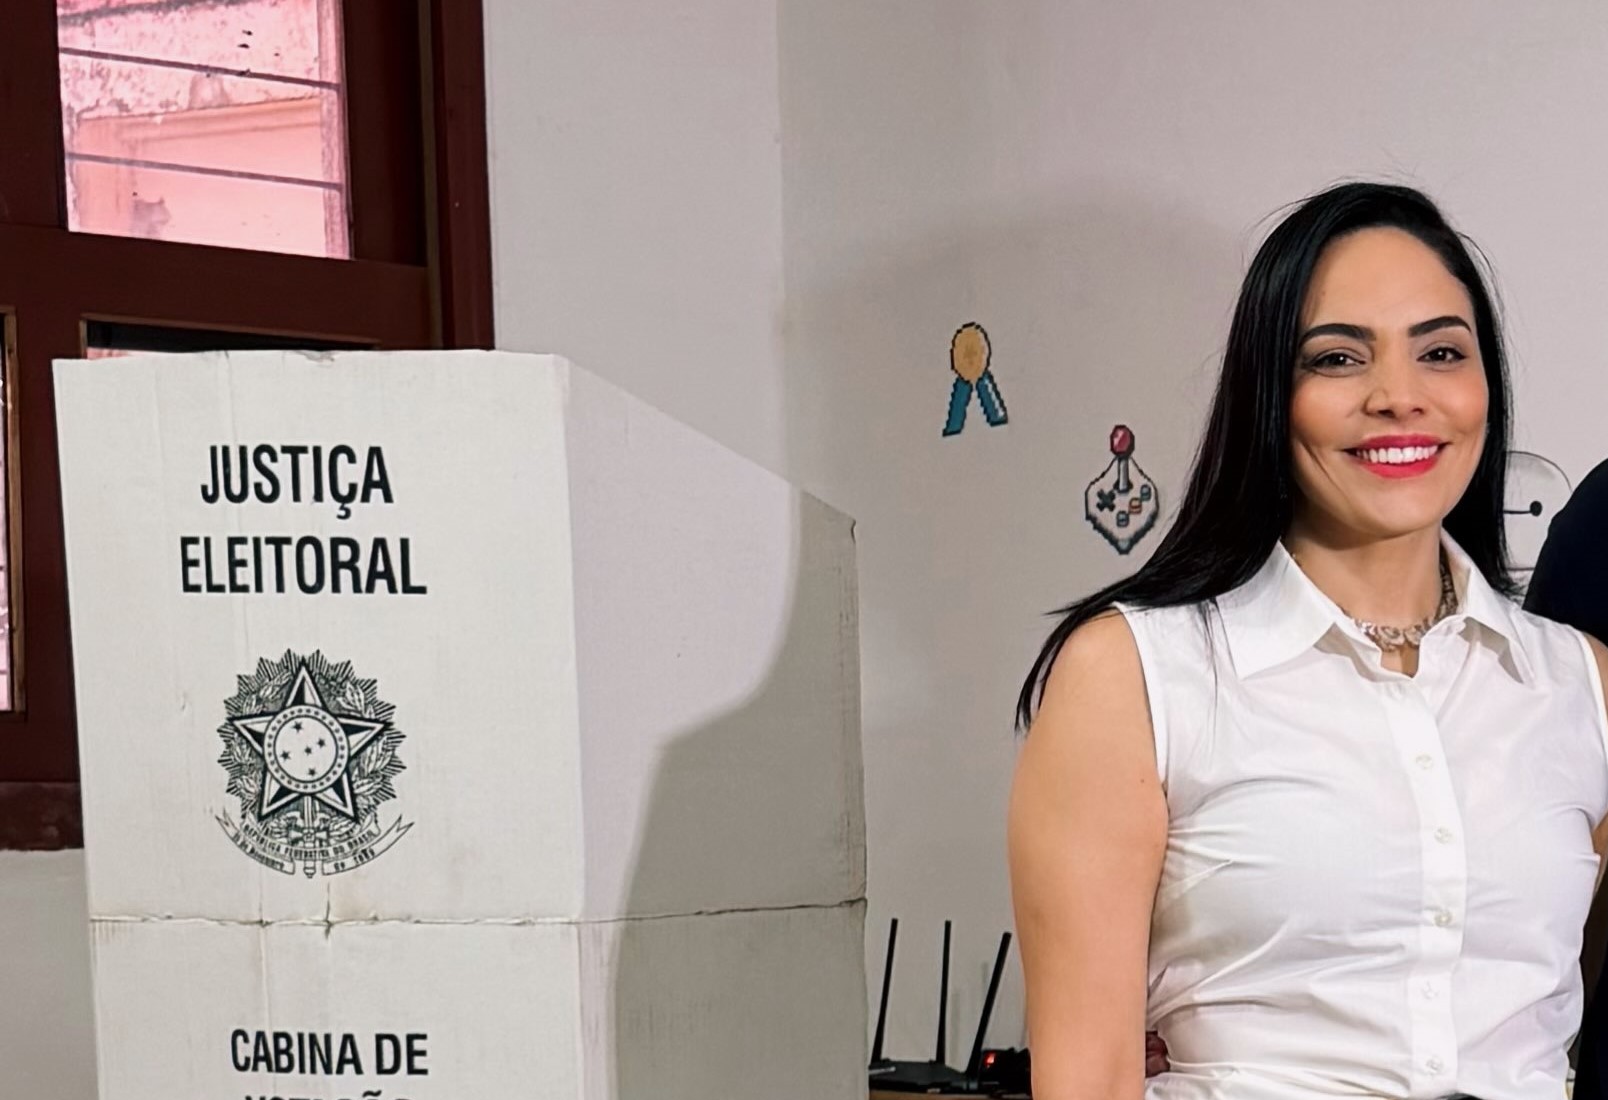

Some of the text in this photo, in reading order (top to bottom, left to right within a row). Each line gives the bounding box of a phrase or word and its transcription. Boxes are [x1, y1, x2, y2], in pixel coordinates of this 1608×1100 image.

[200, 443, 394, 520] JUSTIÇA
[180, 535, 428, 595] ELEITORAL
[230, 1028, 429, 1076] CABINA DE
